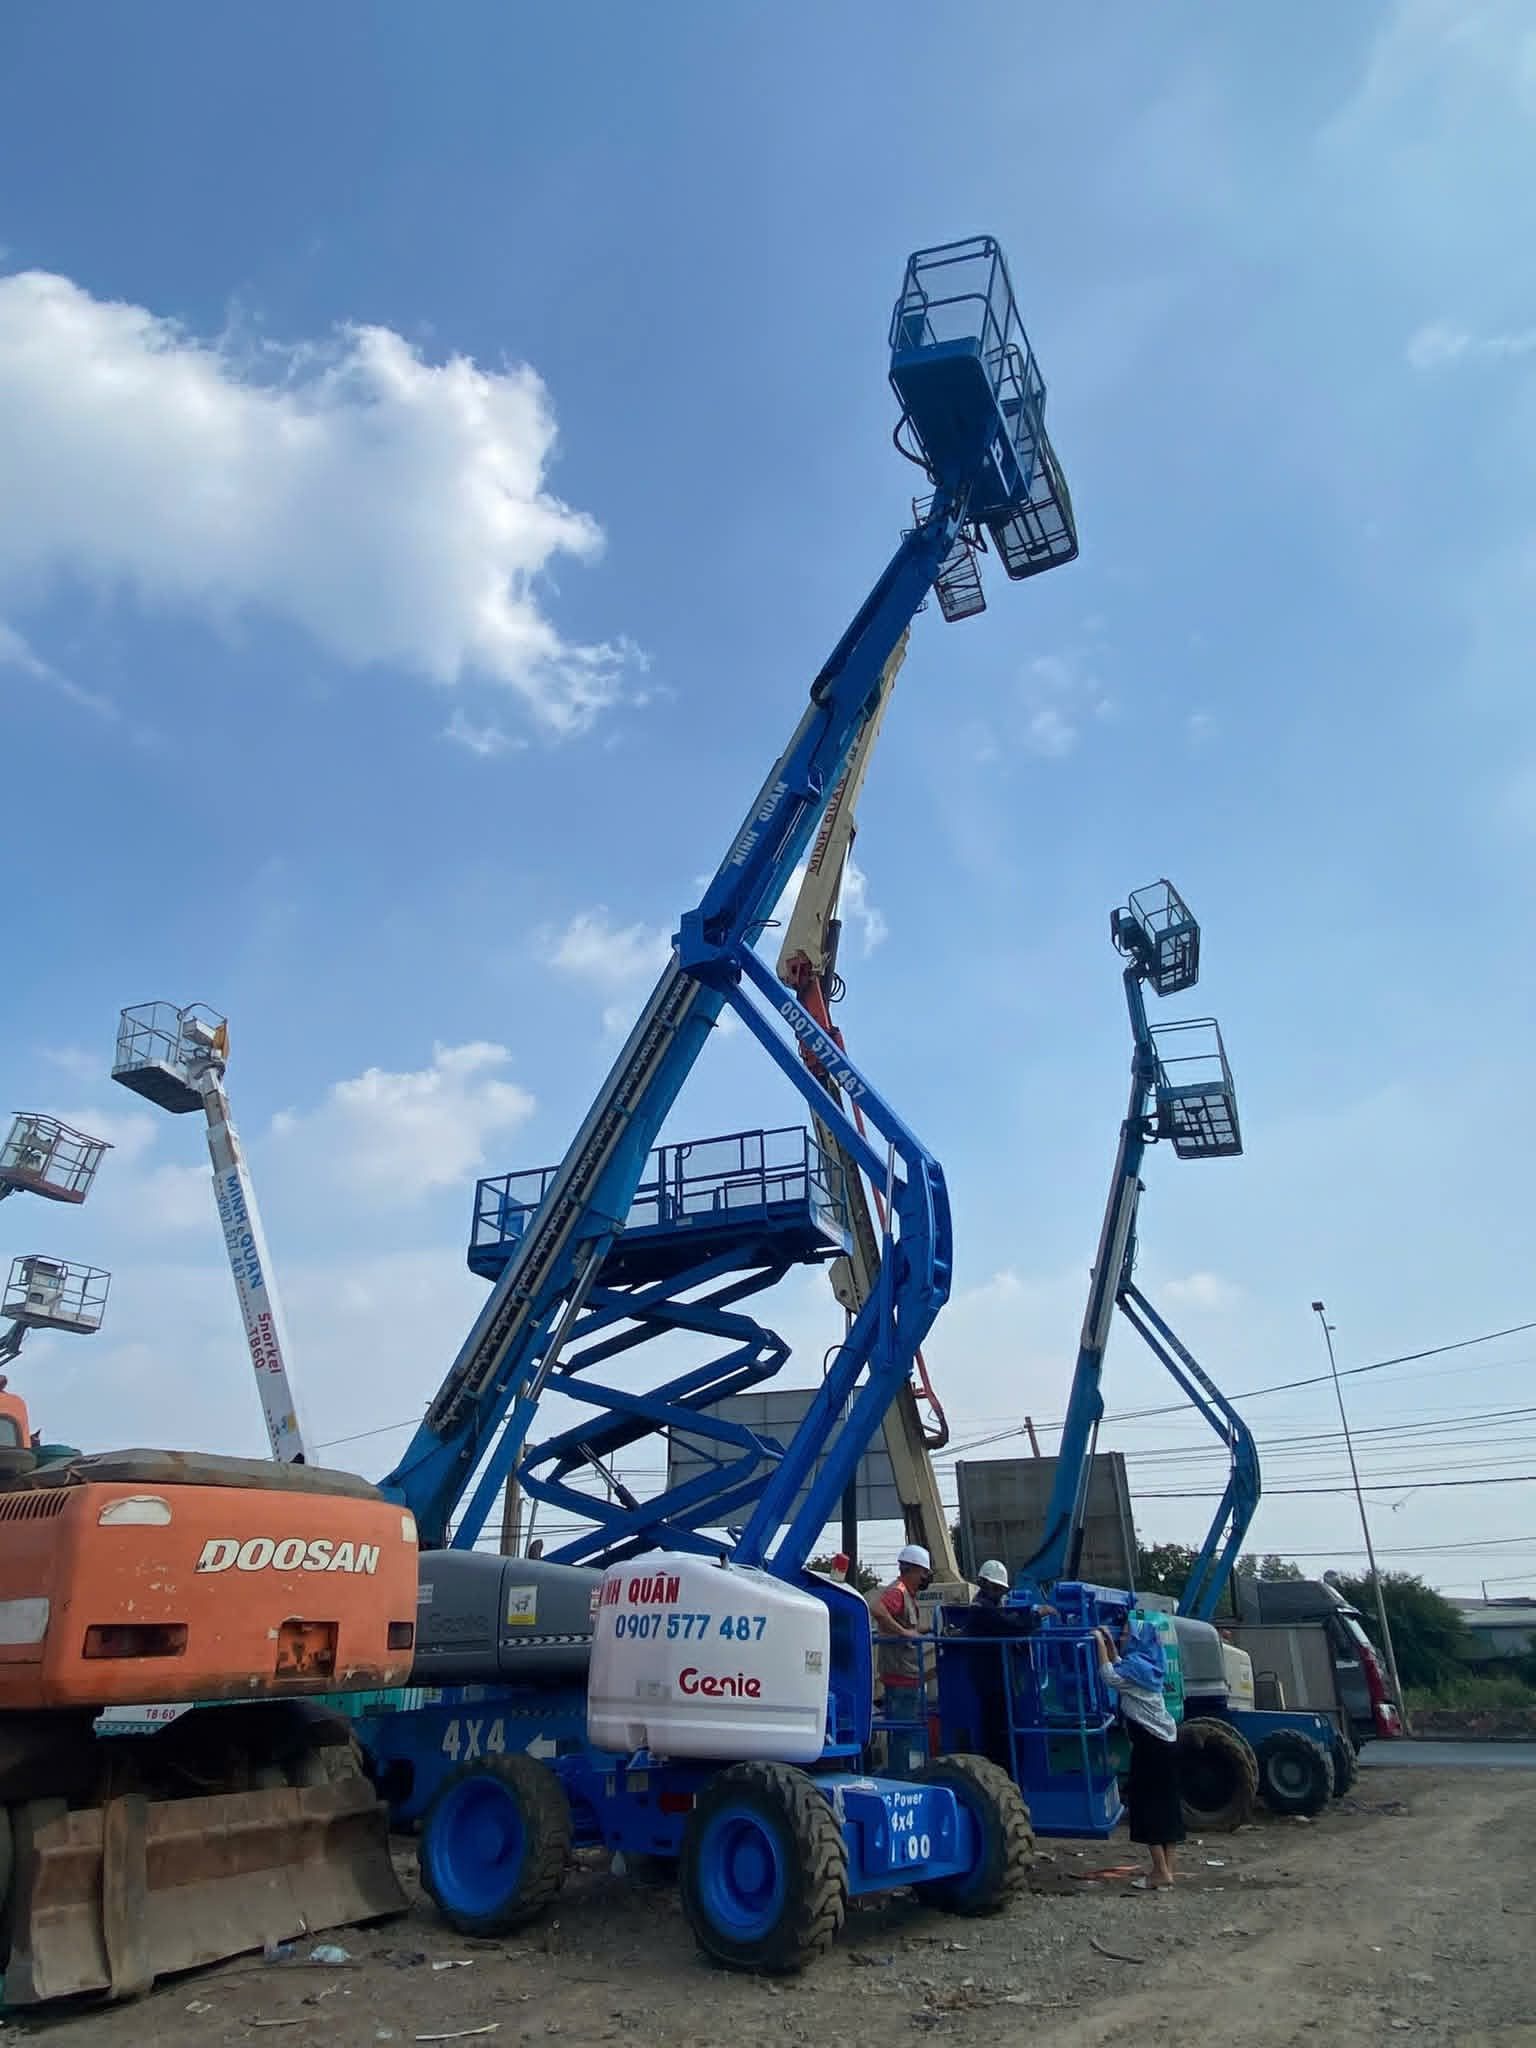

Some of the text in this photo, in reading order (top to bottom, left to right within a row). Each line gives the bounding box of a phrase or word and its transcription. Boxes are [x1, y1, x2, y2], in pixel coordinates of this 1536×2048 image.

[732, 831, 759, 866] MINH
[809, 830, 828, 873] MINH
[780, 1001, 865, 1098] 0907 577 487
[227, 1175, 247, 1224] MINH
[249, 1328, 265, 1369] TB60
[258, 1312, 281, 1374] Snorkel
[194, 1537, 380, 1575] DOOSAN
[628, 1571, 680, 1606] QUÂN
[615, 1613, 767, 1641] 0907 577 487
[679, 1667, 761, 1698] Genie
[894, 1792, 923, 1808] Power
[891, 1809, 914, 1832] 4x4
